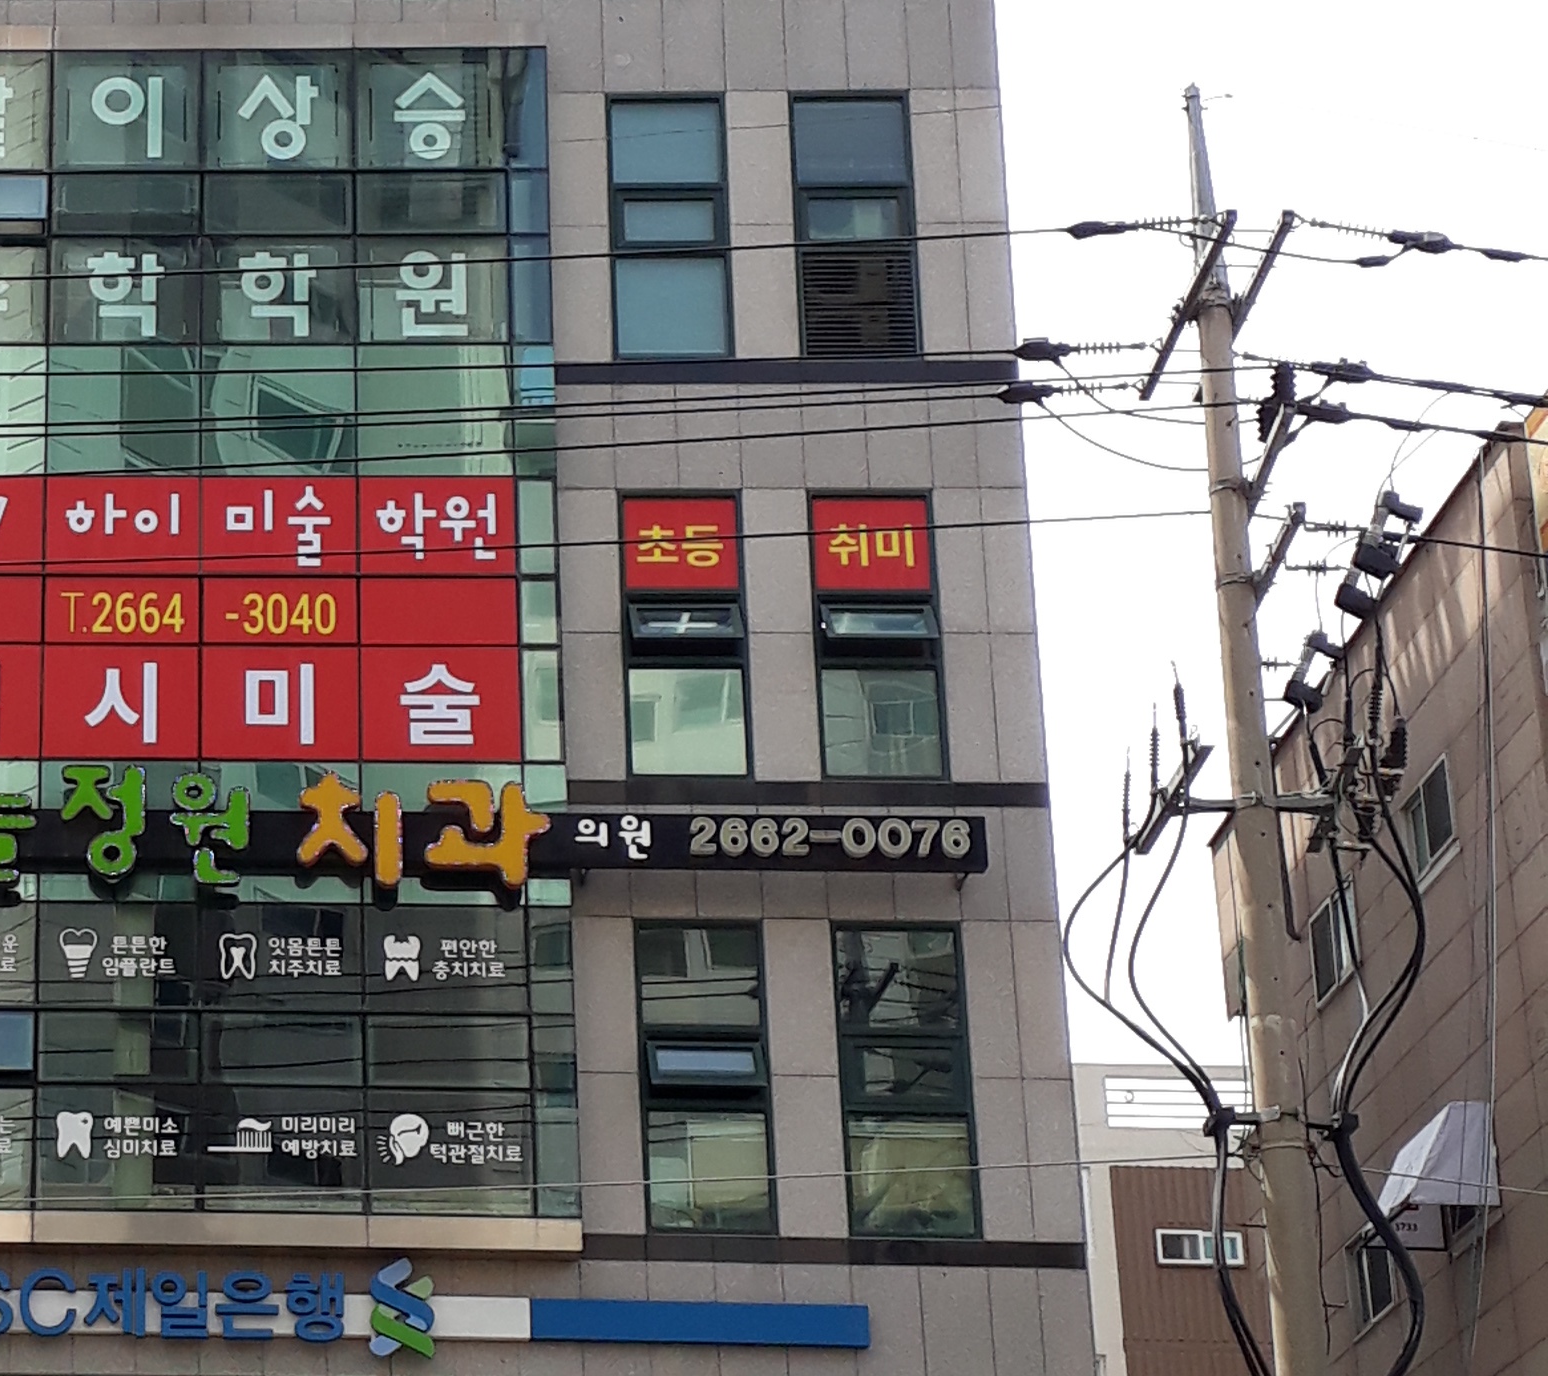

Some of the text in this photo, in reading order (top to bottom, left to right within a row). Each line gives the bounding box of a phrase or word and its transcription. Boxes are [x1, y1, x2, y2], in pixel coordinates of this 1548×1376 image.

[65, 493, 181, 536] 하이
[225, 485, 332, 568] 미술
[376, 492, 498, 561] 학원
[636, 524, 725, 568] 초등
[828, 523, 916, 568] 취미
[296, 771, 551, 889] 치과
[574, 814, 651, 861] 의원
[689, 815, 972, 860] 2662-0076
[111, 935, 168, 956] 튼튼한
[268, 937, 343, 958] 잇몸튼튼
[439, 939, 498, 958] 편안한
[102, 958, 177, 977] 임플란트
[268, 960, 343, 978] 치주치료
[431, 961, 506, 981] 충치치료
[104, 1117, 180, 1135] 예쁜미소
[281, 1117, 356, 1134] 미리미리
[447, 1122, 506, 1142] 뻐근한
[103, 1139, 179, 1159] 심미치료
[281, 1140, 358, 1159] 예방치료
[429, 1144, 524, 1165] 턱관절치료
